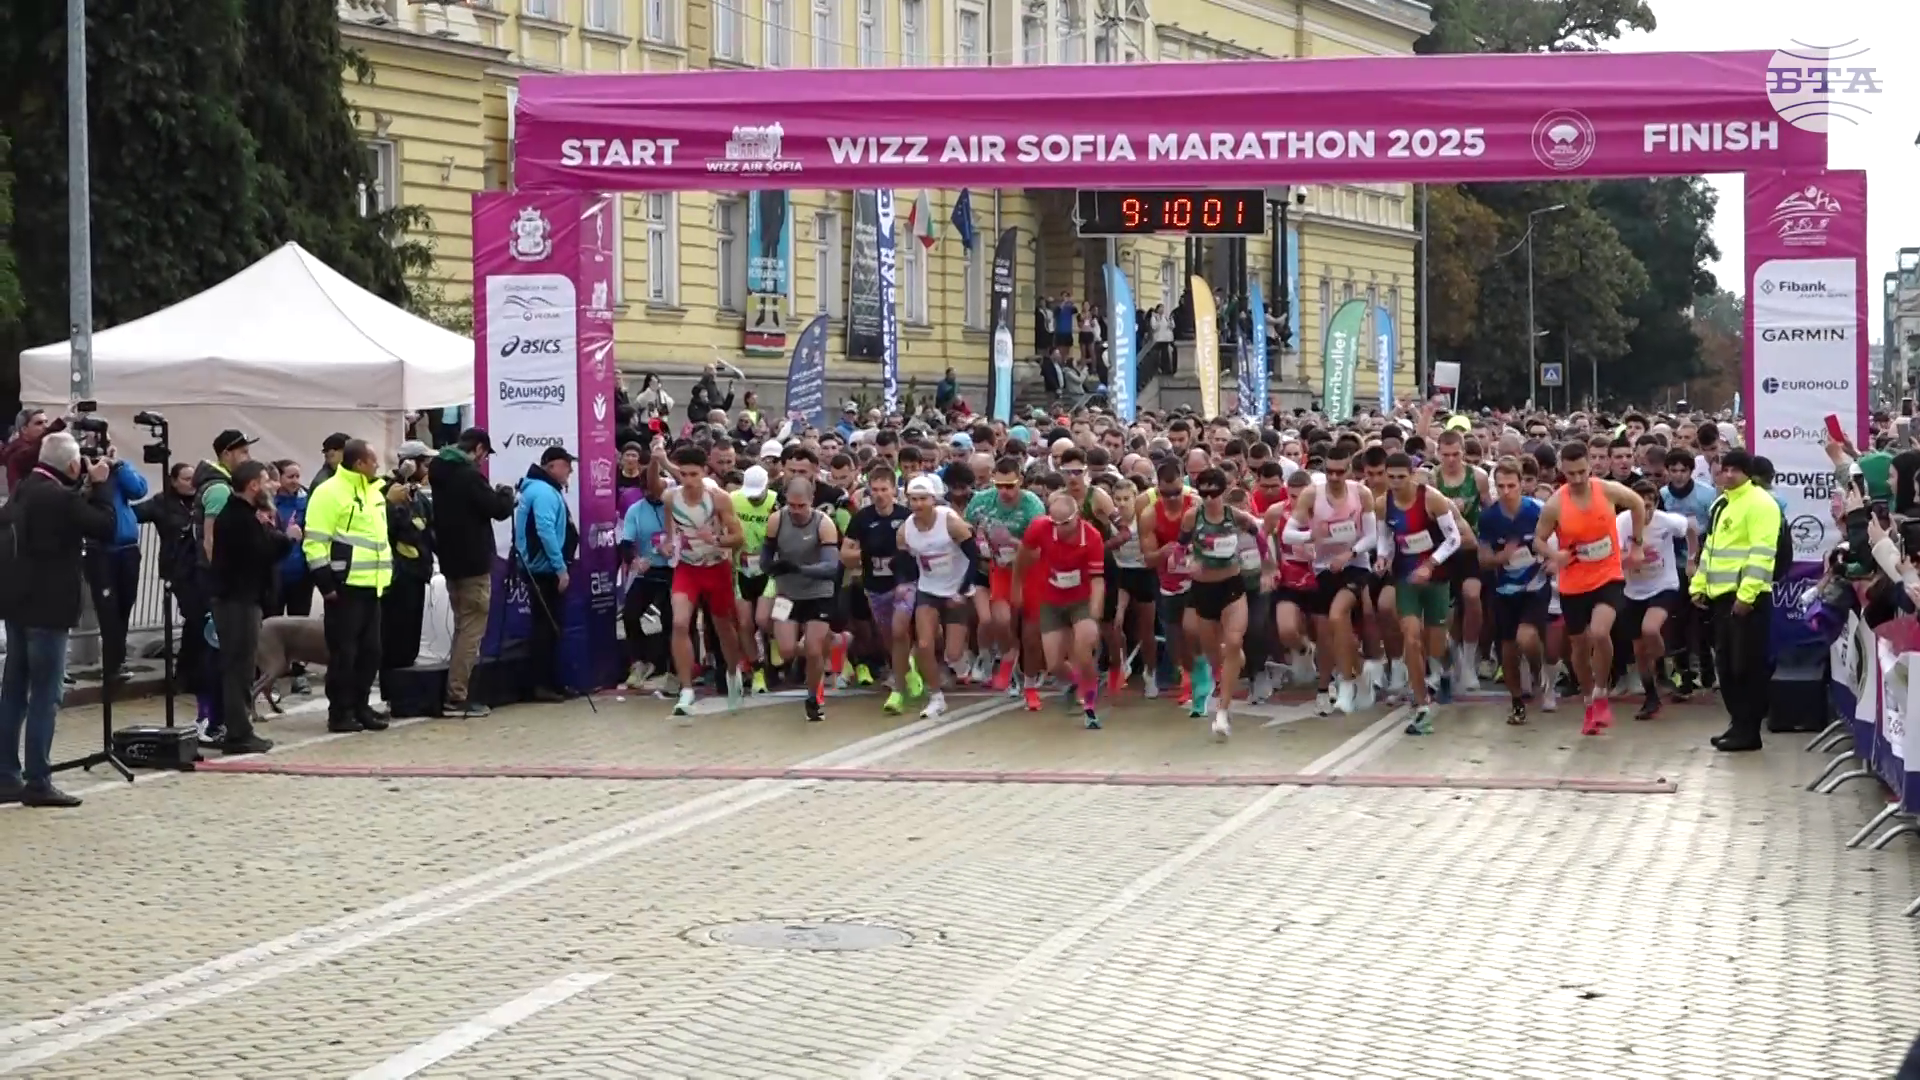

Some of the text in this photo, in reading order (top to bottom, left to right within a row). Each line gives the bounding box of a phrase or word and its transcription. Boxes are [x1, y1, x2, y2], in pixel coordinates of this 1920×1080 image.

[1643, 121, 1779, 153] FINISH
[561, 138, 680, 167] START
[826, 127, 1486, 165] WIZZ AIR SOFIA MARATHON 2025
[706, 160, 803, 172] WIZZ AIR SOFIA
[1778, 281, 1827, 292] Fibank
[1762, 328, 1846, 342] GARMIN
[1329, 331, 1348, 423] nutribullet
[500, 381, 565, 403] Велинград
[1781, 380, 1850, 391] EUROHOLD
[516, 433, 565, 448] Rexona
[1775, 472, 1837, 488] POWER
